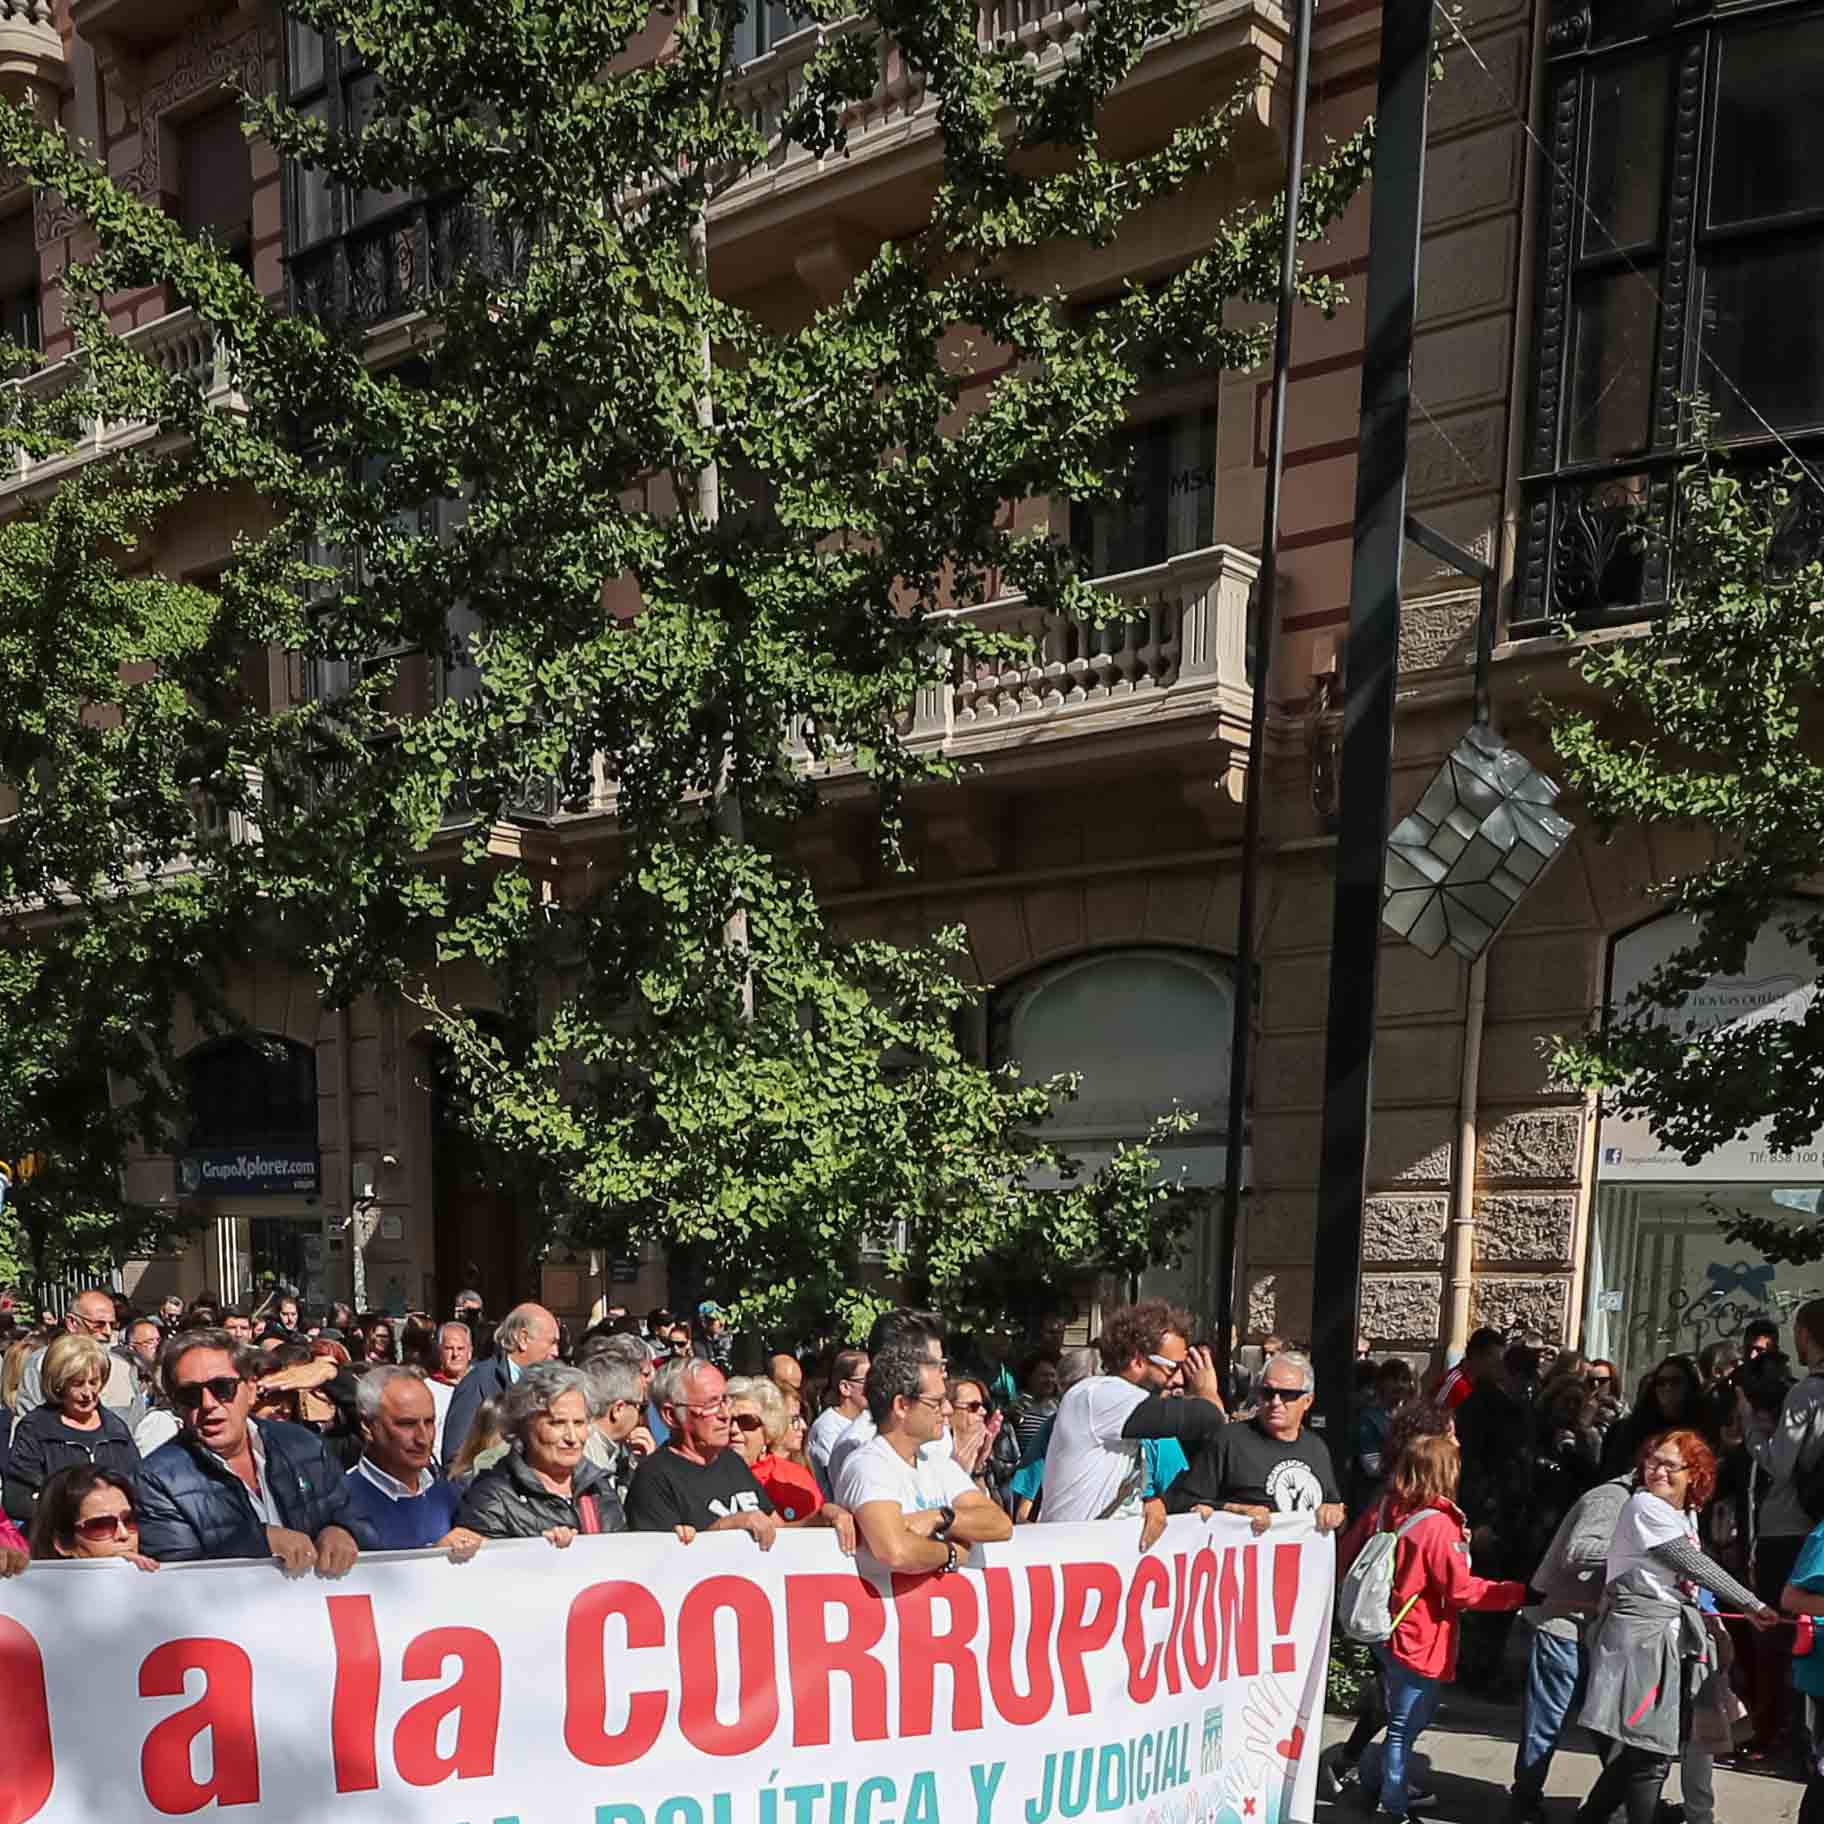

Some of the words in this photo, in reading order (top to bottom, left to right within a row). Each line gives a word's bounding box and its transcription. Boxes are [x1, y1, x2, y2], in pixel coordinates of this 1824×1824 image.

[202, 1154, 315, 1181] GrupoXplorer.com
[137, 1636, 261, 1817] a
[325, 1593, 503, 1795] la
